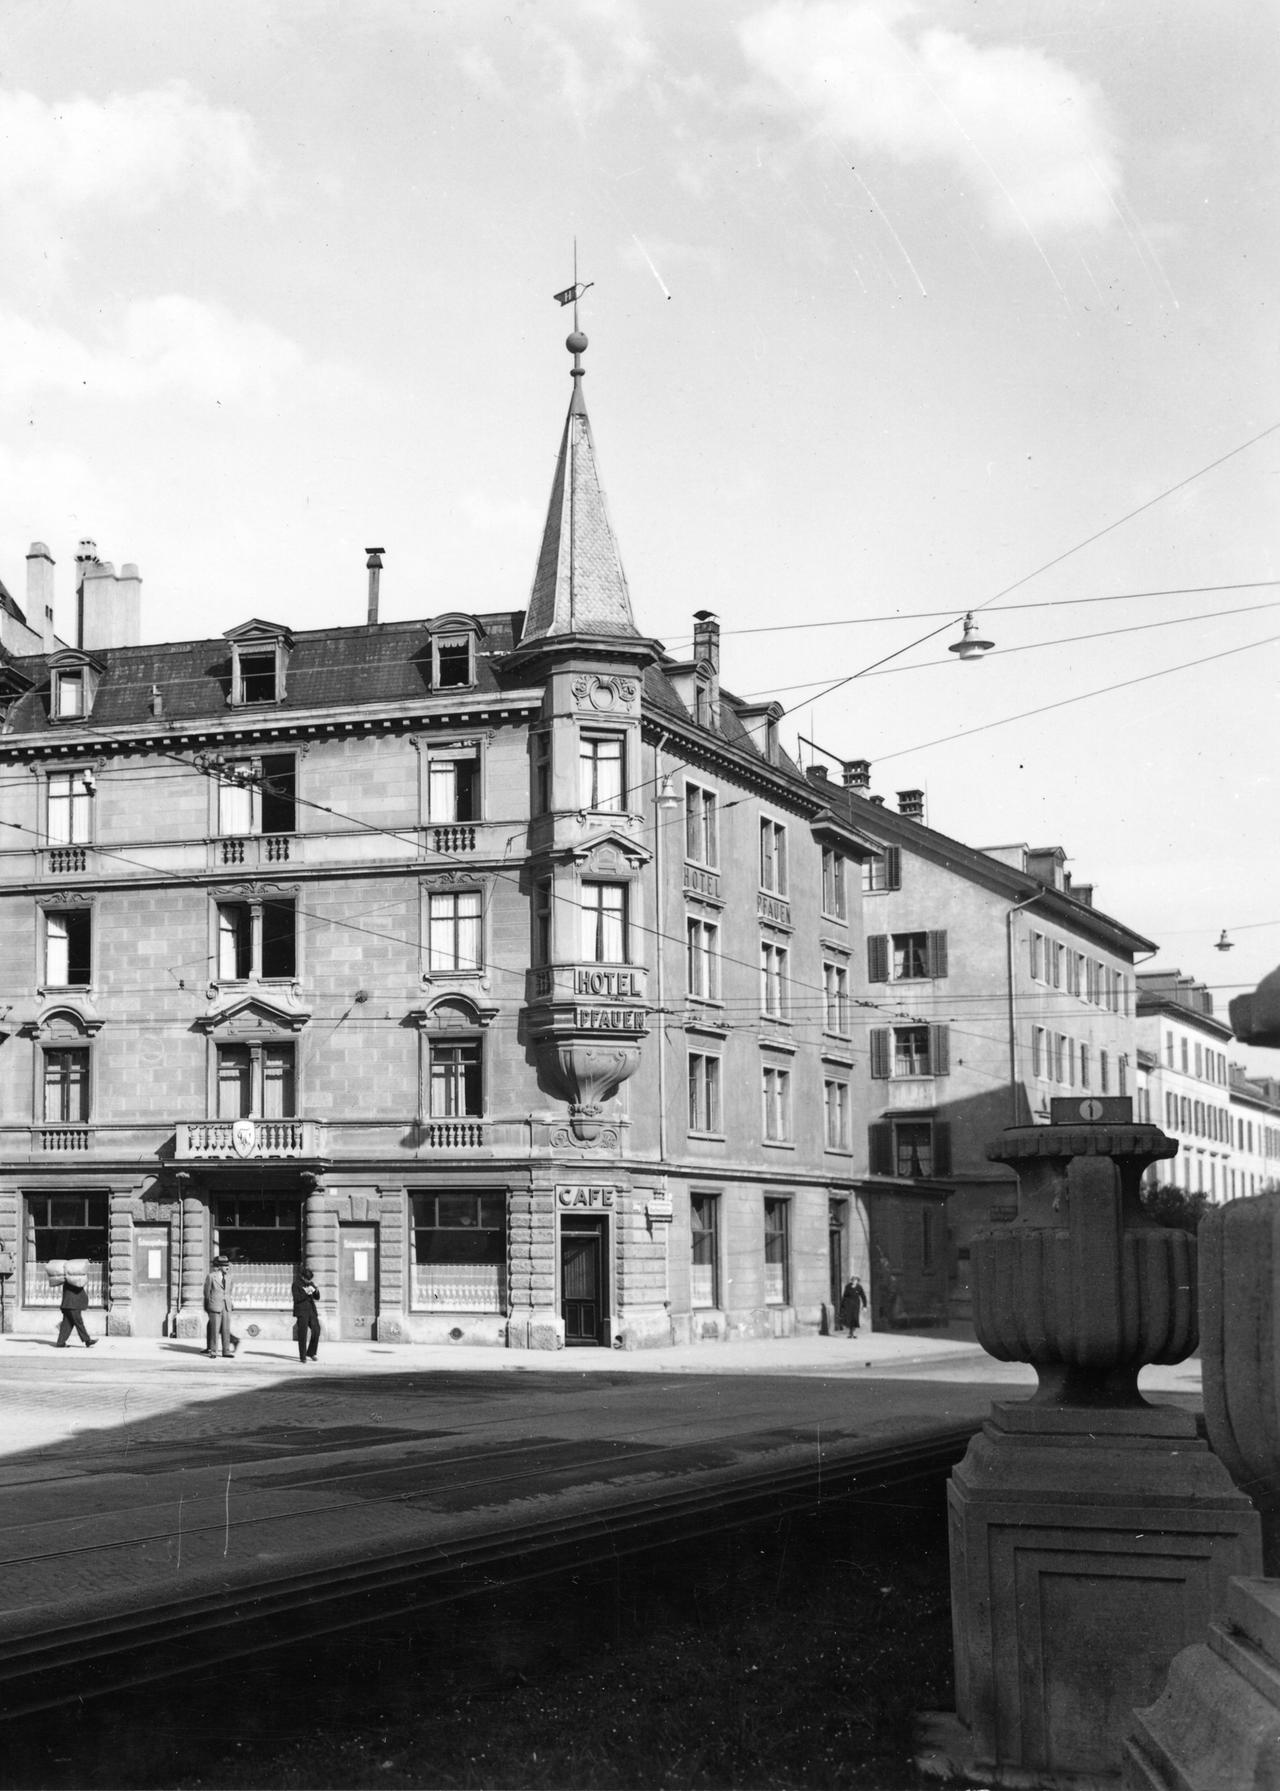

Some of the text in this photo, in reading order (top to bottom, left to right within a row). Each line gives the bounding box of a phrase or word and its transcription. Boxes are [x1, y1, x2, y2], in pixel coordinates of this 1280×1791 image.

[578, 971, 642, 997] HOTEL
[580, 1010, 645, 1029] PFAUEN
[558, 1188, 614, 1207] CAFE
